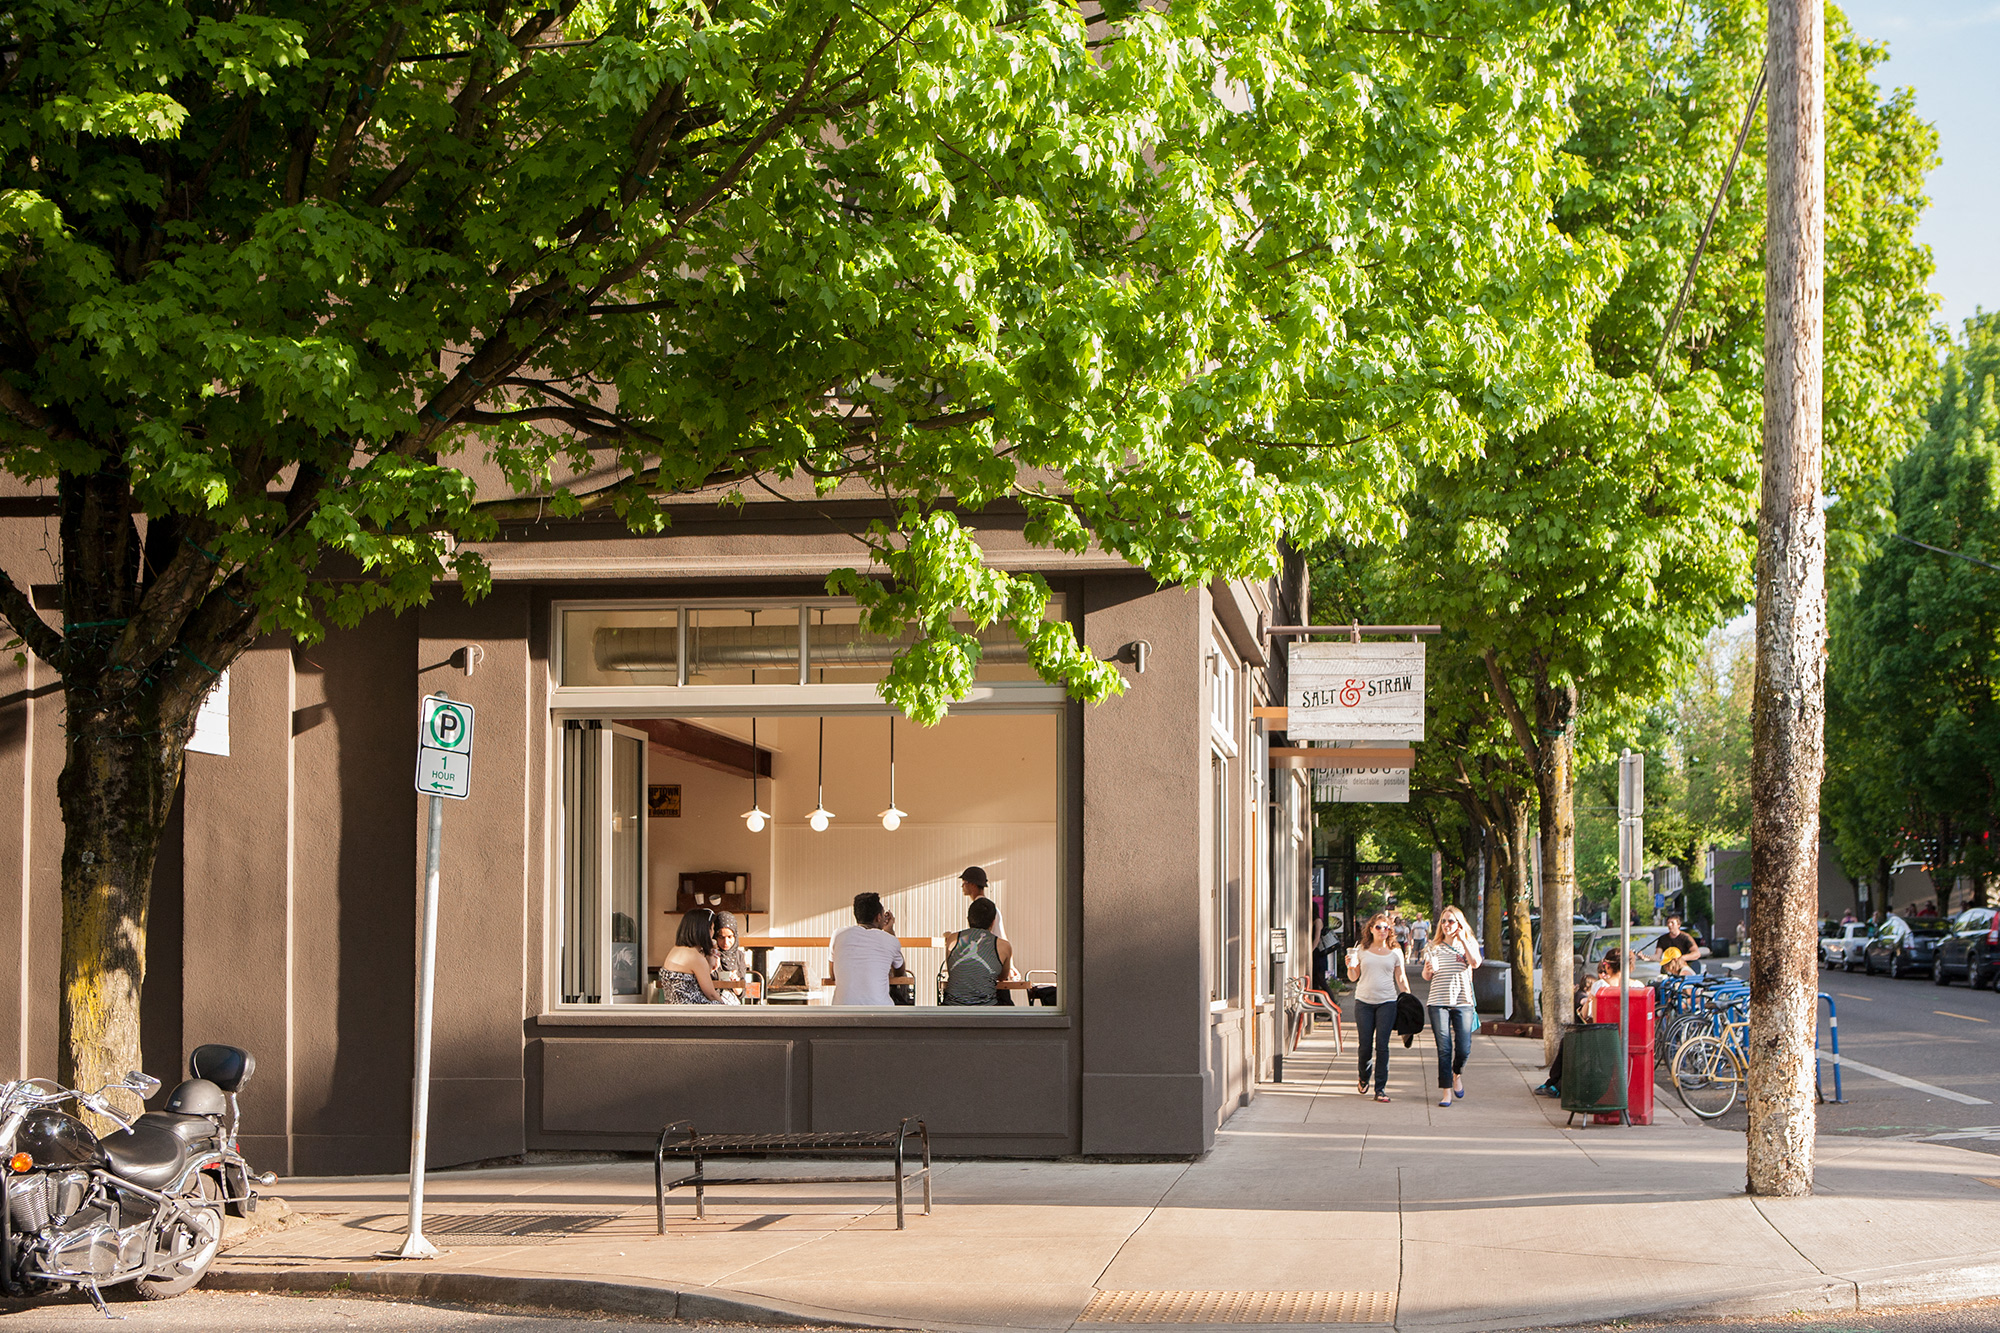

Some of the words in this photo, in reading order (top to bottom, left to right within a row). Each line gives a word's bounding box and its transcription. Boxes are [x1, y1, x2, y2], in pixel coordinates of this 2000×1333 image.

[1302, 689, 1336, 708] SALT
[1340, 679, 1365, 708] &
[1368, 675, 1412, 697] STRAW
[439, 713, 458, 739] P
[441, 756, 447, 770] 1
[432, 770, 455, 781] HOUR
[1353, 777, 1379, 785] delectable
[1383, 777, 1405, 786] possible
